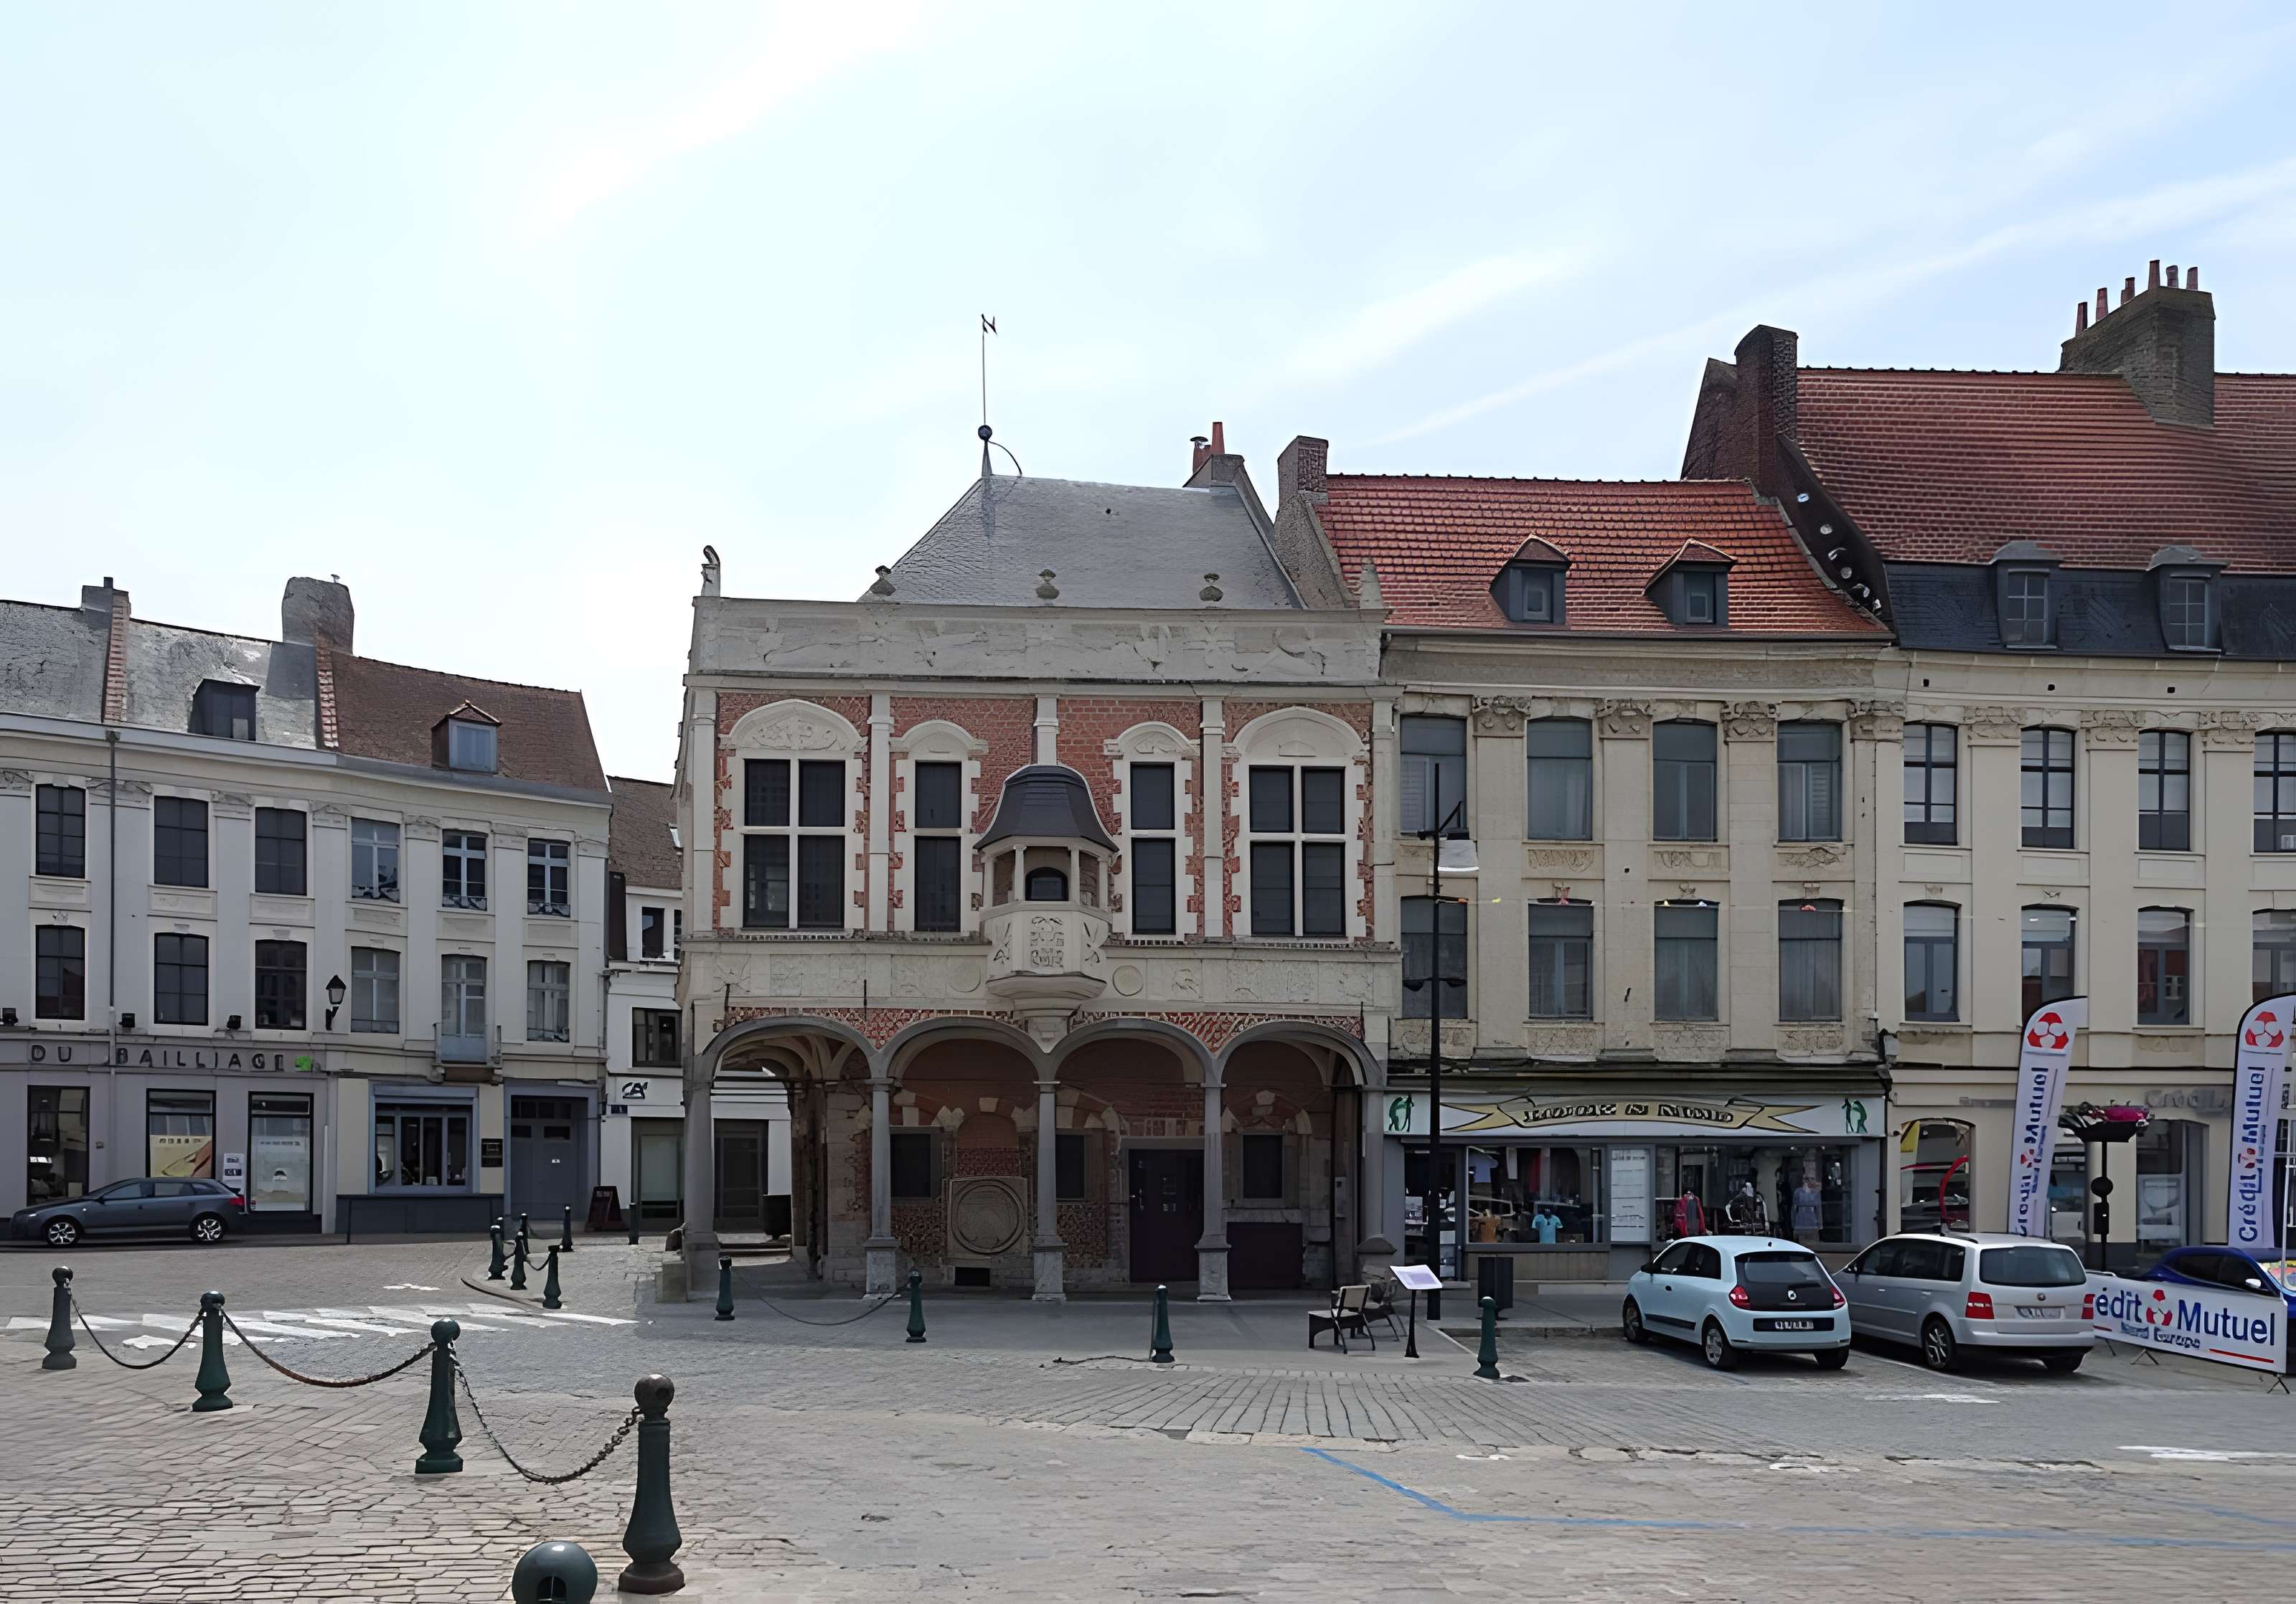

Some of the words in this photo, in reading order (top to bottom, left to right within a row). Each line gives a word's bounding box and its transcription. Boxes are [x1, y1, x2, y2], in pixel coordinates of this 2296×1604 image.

[31, 1044, 72, 1062] DU
[2095, 1286, 2142, 1324] édit
[2178, 1299, 2276, 1346] Mutuel
